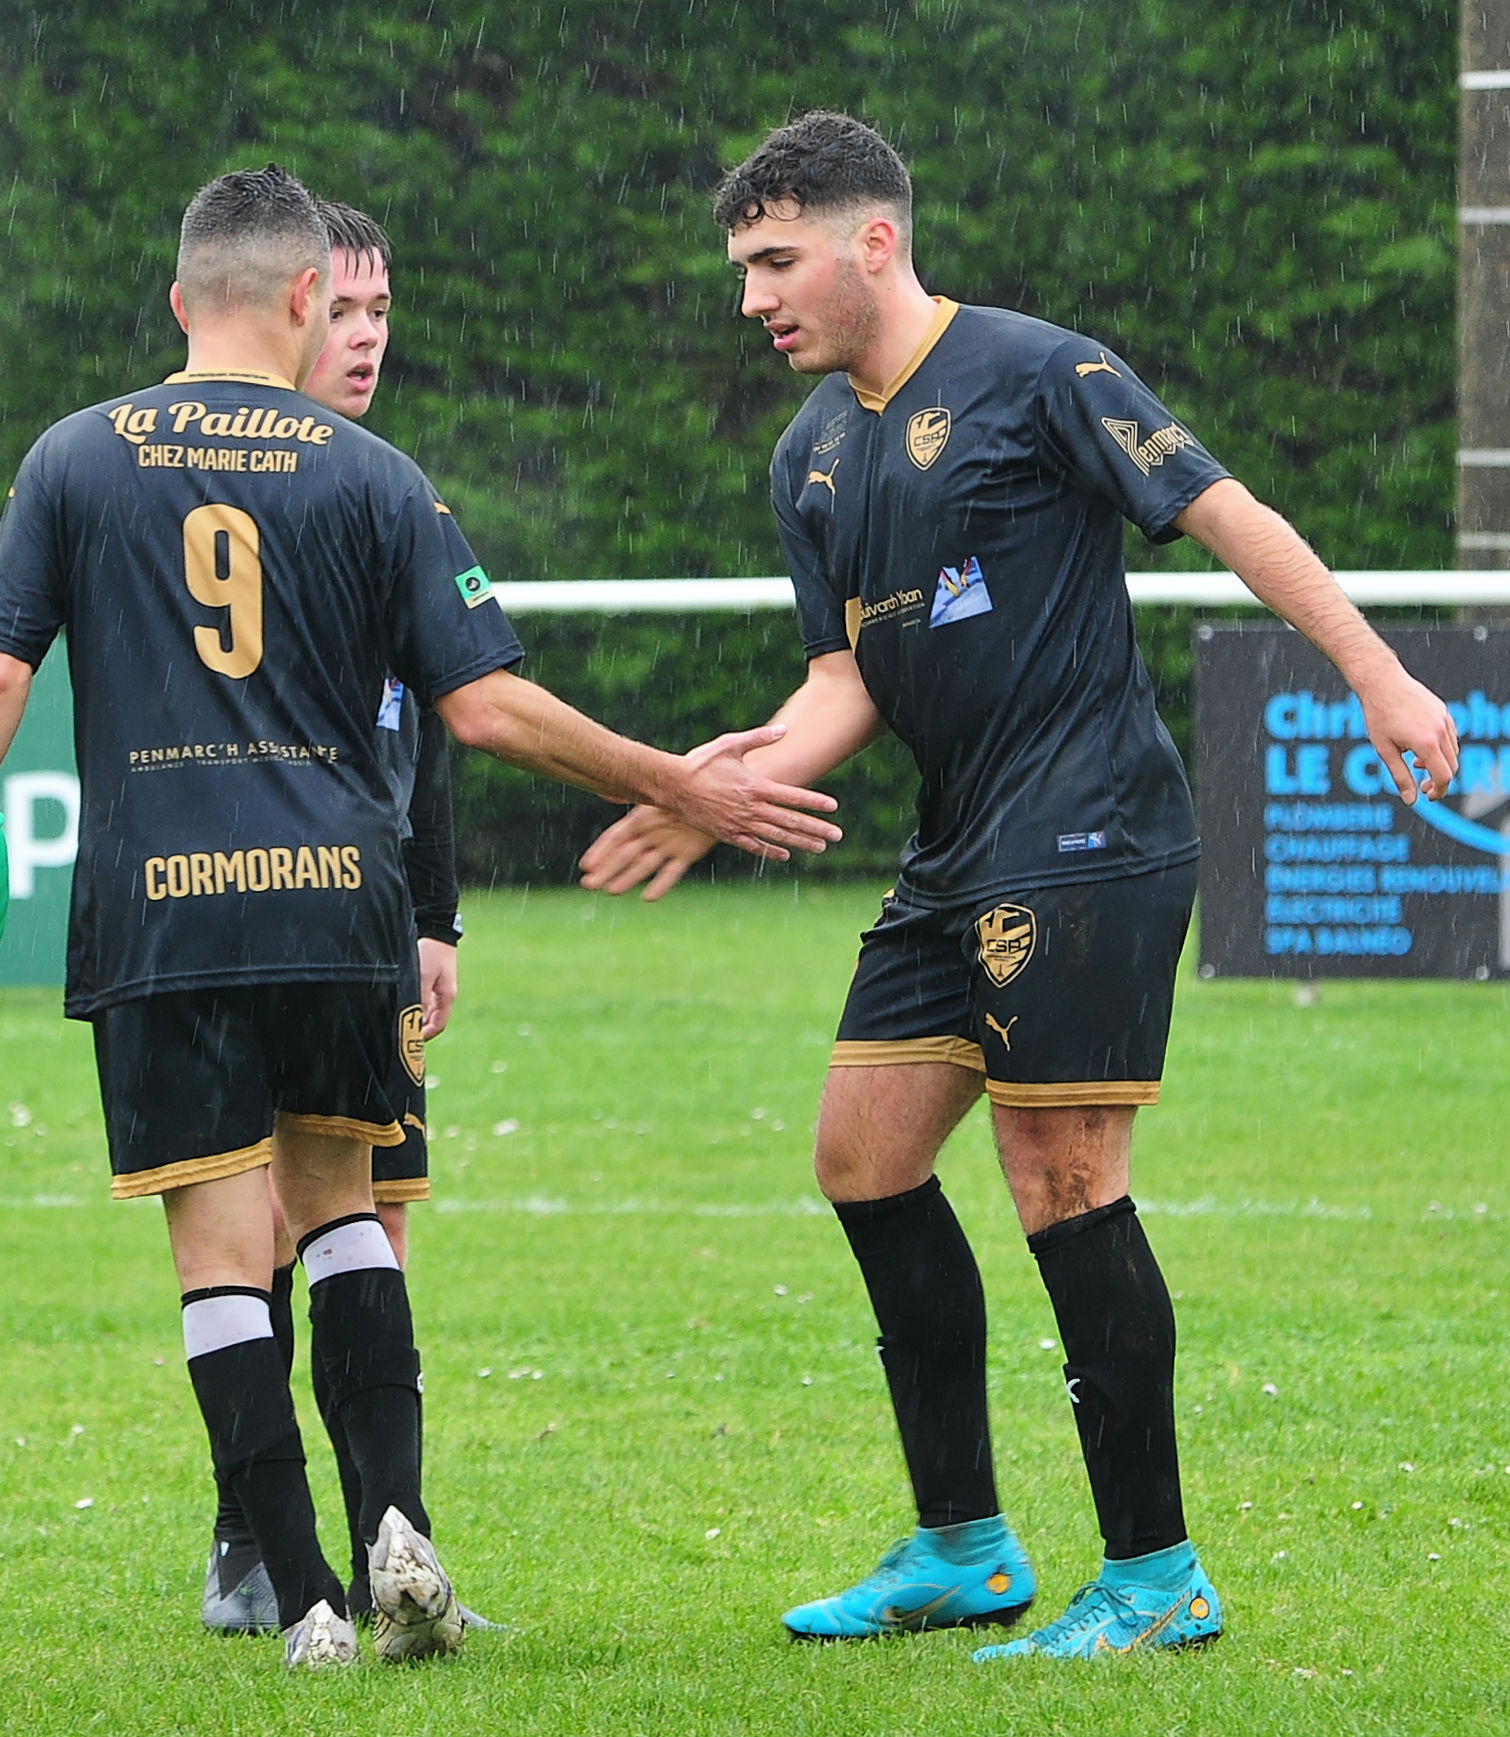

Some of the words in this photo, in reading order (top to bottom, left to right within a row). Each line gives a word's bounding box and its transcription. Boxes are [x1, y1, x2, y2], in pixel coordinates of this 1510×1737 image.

[107, 402, 158, 445] La
[167, 400, 335, 446] Paillote
[138, 444, 185, 468] CHEZ
[186, 447, 248, 472] MARIE
[249, 450, 298, 473] CATH
[182, 502, 264, 680] 9
[1264, 743, 1332, 796] LE
[144, 845, 362, 901] CORMORANS
